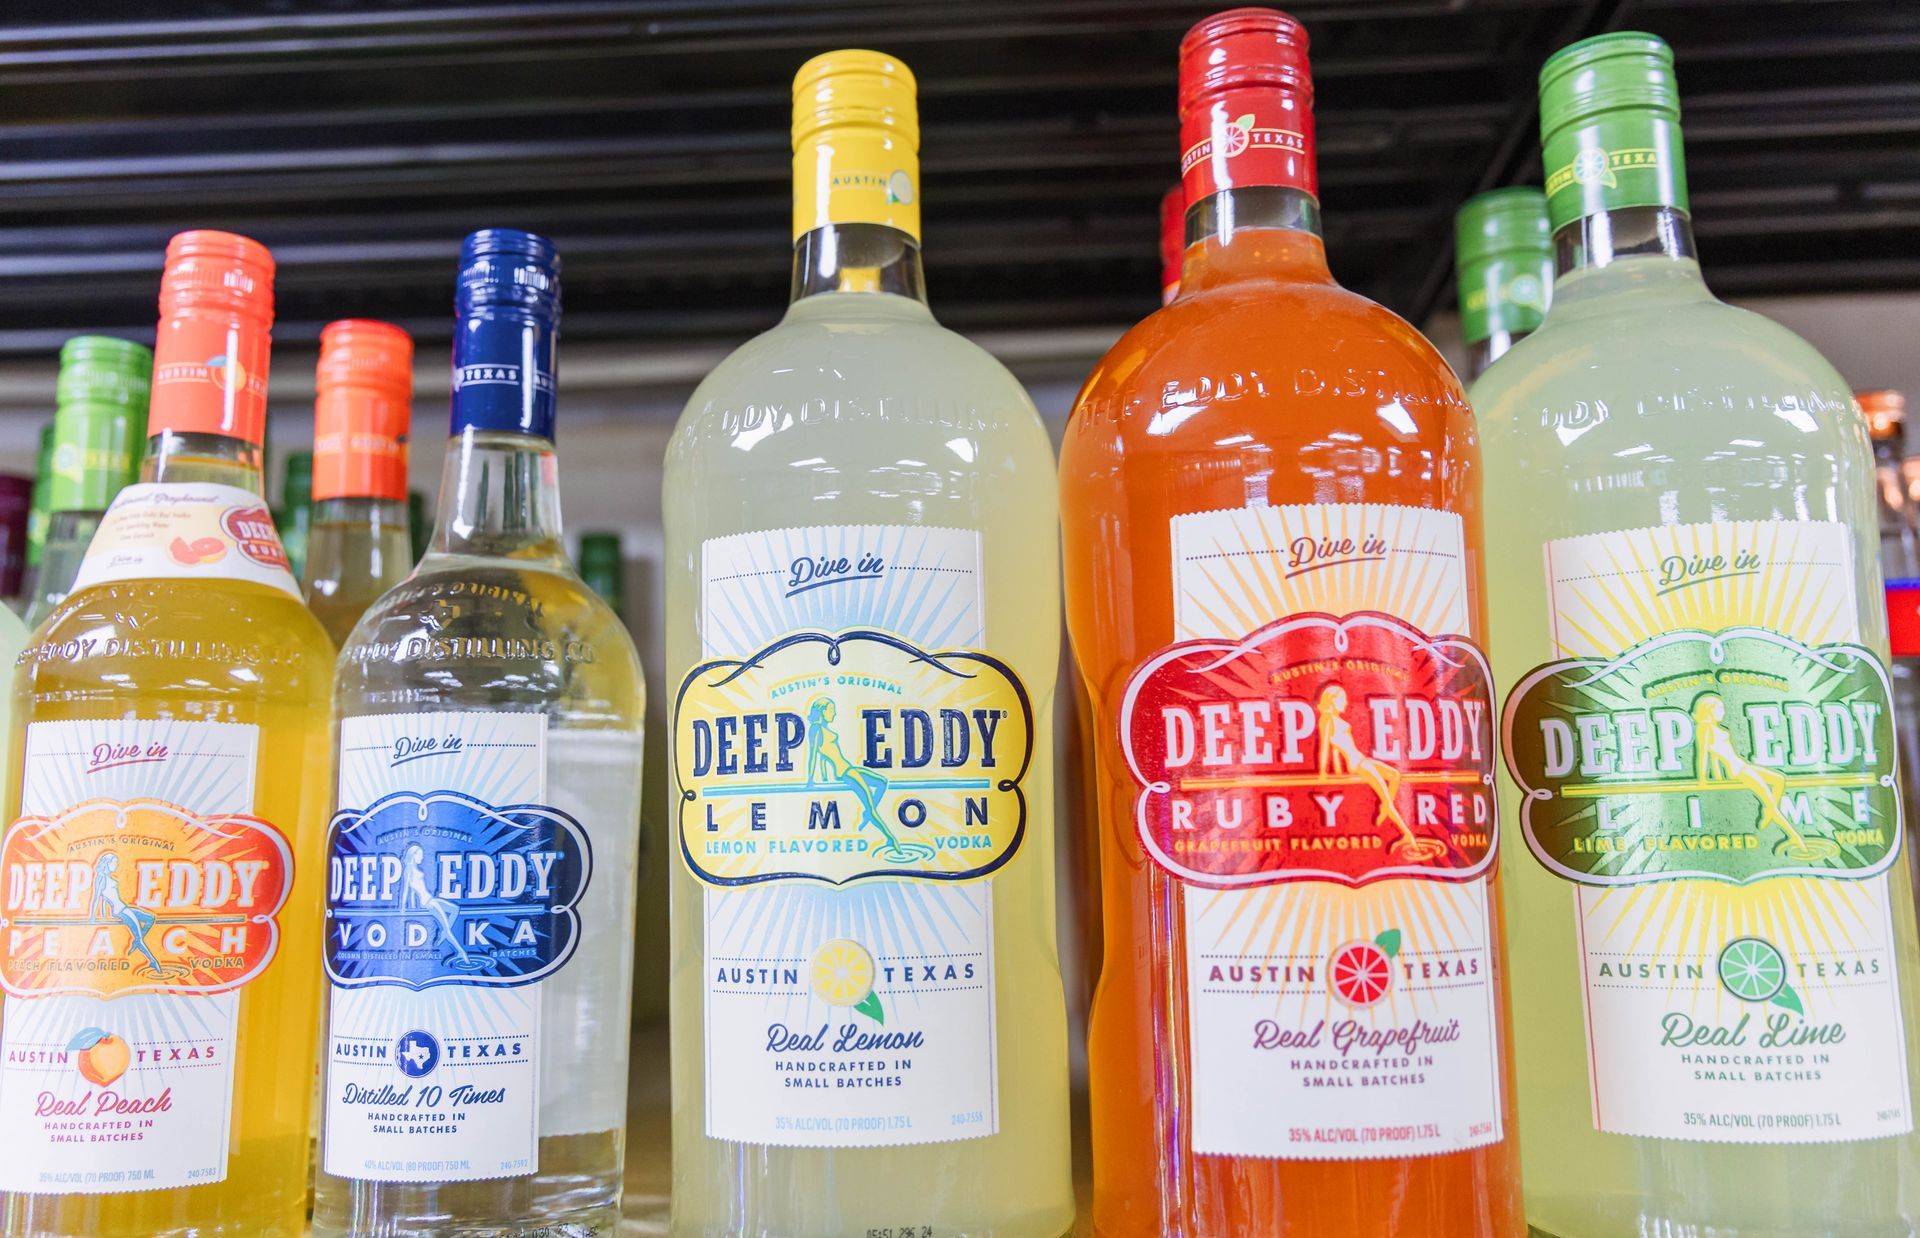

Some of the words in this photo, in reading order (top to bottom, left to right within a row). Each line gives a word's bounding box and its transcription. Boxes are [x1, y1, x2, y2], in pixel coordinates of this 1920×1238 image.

[1181, 143, 1210, 172] USTIN
[1253, 134, 1303, 148] TEXAS
[1612, 153, 1657, 166] TEXA
[832, 177, 887, 186] AUSTIN
[158, 368, 208, 379] AUSTIN
[466, 368, 517, 380] TEXAS
[1289, 537, 1355, 567] Dive
[1362, 534, 1387, 554] in
[789, 557, 851, 586] Dive
[858, 553, 884, 573] in
[1659, 555, 1725, 585] Dive
[1734, 550, 1761, 570] in
[771, 675, 830, 699] AUSTIN'S
[837, 675, 903, 695] ORIGINAL
[1647, 676, 1714, 698] AUSTIN'S
[1722, 674, 1789, 692] ORIGINAL
[1162, 699, 1316, 768] DEEP
[1370, 698, 1485, 761] EDDY
[1540, 707, 1694, 777] DEEP
[1747, 701, 1880, 768] EDDY
[90, 743, 141, 766] Dive
[147, 742, 168, 758] in
[394, 736, 438, 760] Dive
[442, 734, 463, 749] in
[693, 711, 806, 777] DEEP
[706, 797, 989, 832] LEMON
[1172, 796, 1344, 831] RUBY
[1418, 794, 1487, 825] RED
[1597, 791, 1871, 830] LIME
[69, 837, 116, 852] AUSTIN'S
[121, 837, 176, 852] ORIGINAL
[706, 841, 757, 855] LEMON
[769, 839, 869, 854] FLAVORED
[934, 836, 992, 850] VODKA
[1174, 837, 1281, 853] GRAPEFRUIT
[1291, 836, 1382, 851] FLAVORED
[1450, 834, 1488, 848] VODKA
[1573, 837, 1626, 854] LIME
[1645, 834, 1760, 851] FLAVORED
[1835, 830, 1884, 847] VODKA
[8, 862, 92, 910] DEEP
[136, 861, 260, 908] EDDY
[331, 855, 402, 902] DEEP
[439, 852, 556, 899] EDDY
[8, 926, 247, 957] PEACH
[340, 920, 537, 948] VODKA
[49, 960, 131, 972] FLAVORED
[190, 958, 244, 969] VODKA
[400, 952, 411, 960] IN
[414, 951, 443, 961] SMALL
[492, 949, 537, 958] BATCHES
[717, 967, 798, 984] AUSTIN
[884, 963, 974, 982] TEXAS
[1208, 965, 1316, 983] AUSTIN
[1404, 959, 1478, 980] TEXAS
[1598, 962, 1704, 979] AUSTIN
[1797, 959, 1879, 977] TEXAS
[766, 1023, 829, 1053] Real
[833, 1024, 924, 1052] Lemon
[1253, 1019, 1325, 1049] Real
[1332, 1019, 1460, 1056] Grapefruit
[1661, 1012, 1750, 1048] Real
[1759, 1013, 1846, 1048] Lime
[9, 1050, 69, 1064] AUSTIN
[137, 1046, 216, 1063] TEXAS
[336, 1043, 387, 1058] AUSTIN
[447, 1042, 522, 1058] TEXAS
[1681, 1054, 1804, 1065] HANDCRAFTED
[1814, 1054, 1830, 1064] IN
[775, 1060, 886, 1072] HANDCRAFTED
[895, 1060, 912, 1070] IN
[1290, 1058, 1409, 1071] HANDCRAFTED
[1418, 1056, 1433, 1067] IN
[785, 1077, 829, 1088] SMALL
[837, 1076, 902, 1088] BATCHES
[1303, 1076, 1354, 1088] SMALL
[1361, 1073, 1425, 1087] BATCHES
[1694, 1070, 1745, 1081] SMALL
[1755, 1070, 1822, 1081] BATCHES
[35, 1090, 92, 1117] Real
[94, 1087, 173, 1117] Peach
[342, 1082, 412, 1106] Distilled
[416, 1085, 443, 1108] 10
[449, 1084, 506, 1107] Times
[44, 1121, 132, 1131] HANDCRAFTED
[139, 1119, 153, 1129] IN
[368, 1112, 445, 1121] HANDCRAFTED
[452, 1112, 466, 1121] IN
[776, 1117, 793, 1129] 35%
[795, 1117, 833, 1131] ALC/VOL
[835, 1117, 850, 1132] (70
[851, 1117, 886, 1132] PROOF)
[887, 1117, 905, 1129] 1.75
[906, 1117, 912, 1128] L
[1684, 1113, 1706, 1126] 35%
[1709, 1113, 1755, 1128] ALC/VOL
[1757, 1114, 1774, 1130] (70
[1776, 1114, 1814, 1129] PROOF)
[1816, 1114, 1834, 1126] 1.75
[1835, 1114, 1841, 1125] L
[50, 1133, 85, 1143] SMALL
[91, 1132, 144, 1142] BATCHES
[373, 1124, 404, 1134] SMALL
[409, 1124, 457, 1134] BATCHES
[1289, 1129, 1311, 1142] 35%
[1314, 1128, 1358, 1143] ALC/VOL
[1361, 1127, 1377, 1143] (70
[1379, 1126, 1415, 1142] PROOF)
[1417, 1125, 1434, 1138] 1.75
[1435, 1124, 1441, 1137] L
[364, 1160, 376, 1170] 40%
[377, 1160, 405, 1171] ALC/VOL
[418, 1160, 445, 1171] PROOF)
[445, 1160, 458, 1170] 750
[460, 1160, 471, 1170] ML
[54, 1172, 83, 1184] ALC/VOL
[85, 1172, 97, 1184] (70
[98, 1171, 125, 1183] PROOF)
[128, 1170, 142, 1181] 750
[143, 1169, 155, 1180] ML
